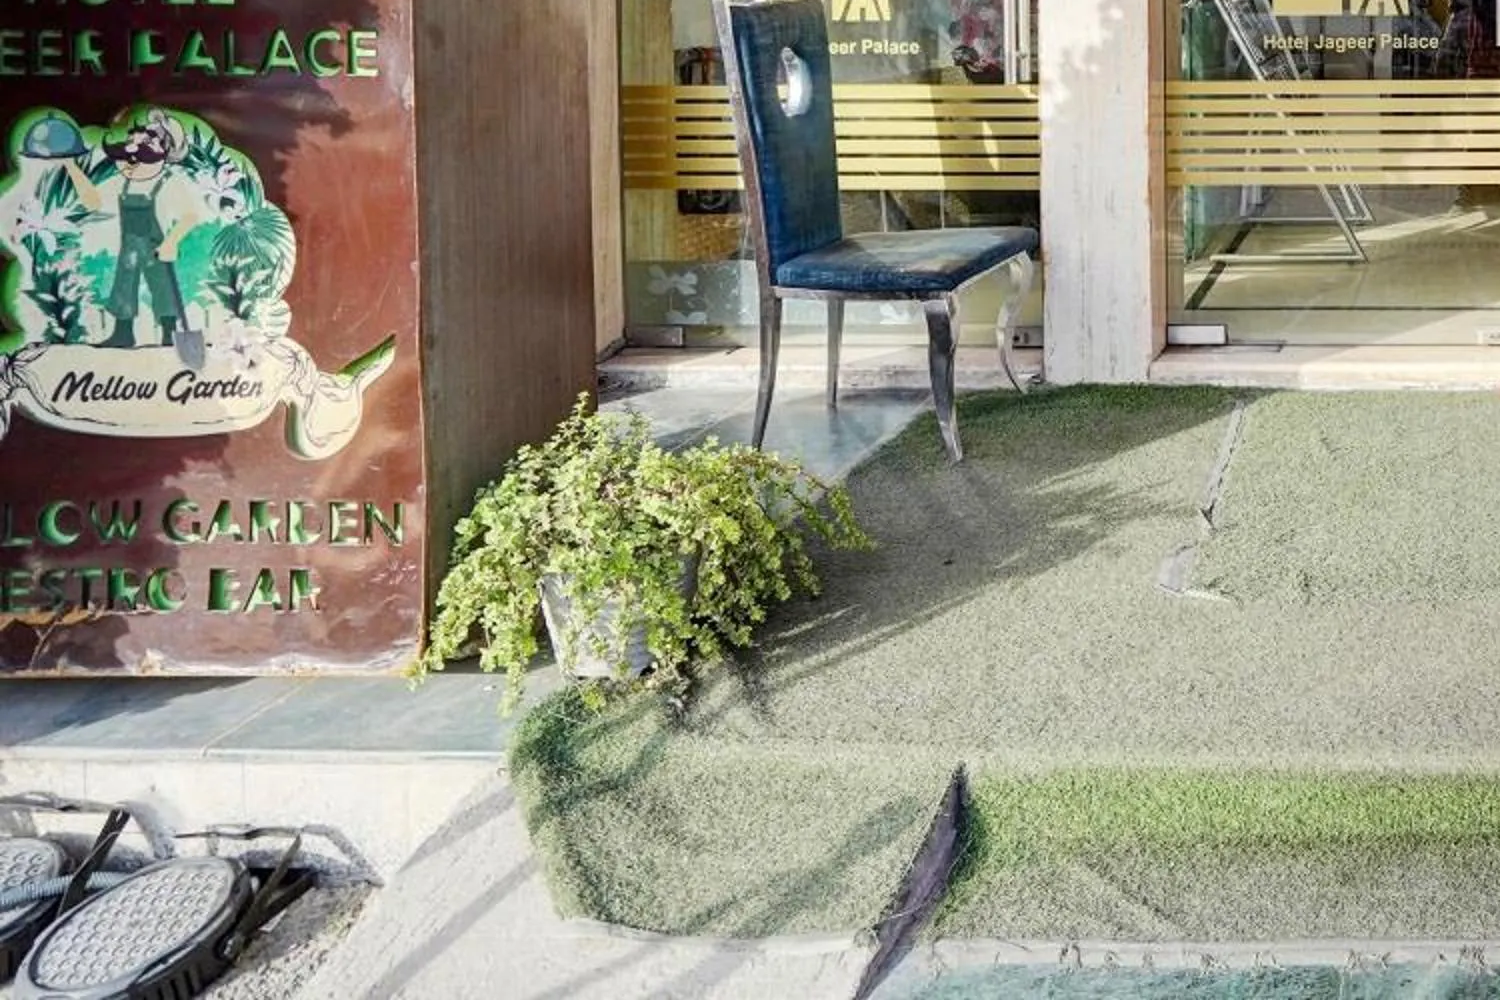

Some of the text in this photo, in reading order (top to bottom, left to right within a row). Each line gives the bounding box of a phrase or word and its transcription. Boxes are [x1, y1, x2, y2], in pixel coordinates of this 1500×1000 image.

[128, 27, 380, 78] PALACE
[861, 39, 920, 55] Palace
[1263, 33, 1440, 52] Hotel Jageer Palace
[51, 369, 263, 405] Mellow Garden
[158, 499, 404, 547] GARDEN
[207, 567, 322, 615] BAR
